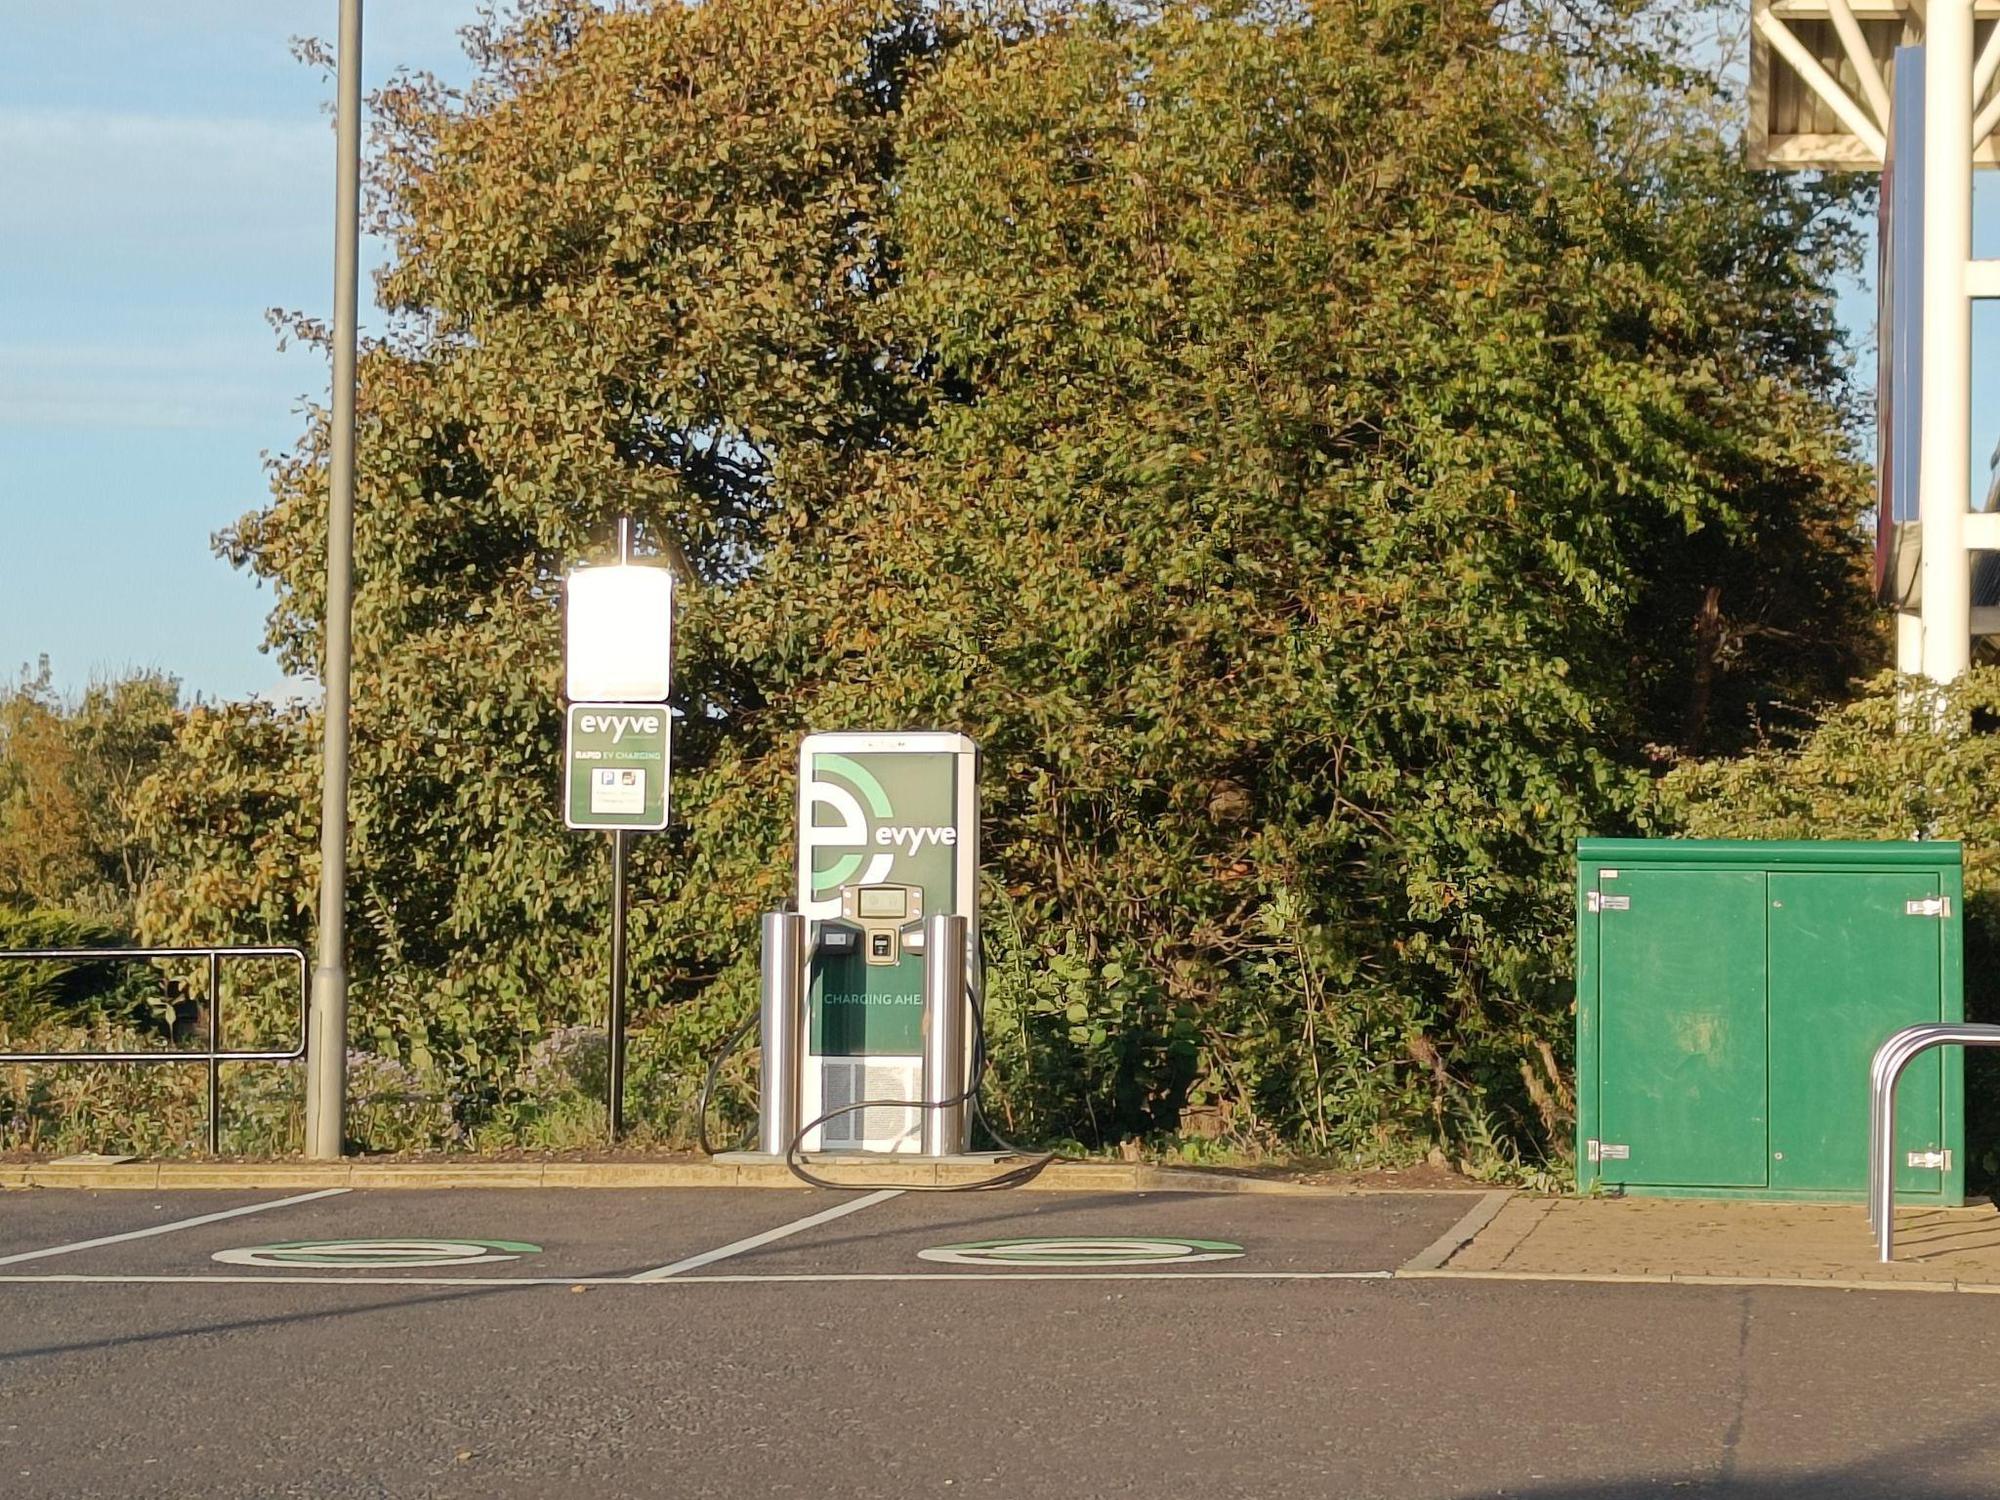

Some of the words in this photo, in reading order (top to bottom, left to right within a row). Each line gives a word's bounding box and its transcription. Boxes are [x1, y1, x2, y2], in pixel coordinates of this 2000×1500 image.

[580, 714, 659, 744] evyve
[875, 826, 957, 857] evyve
[824, 993, 892, 1005] CHARGING
[894, 993, 924, 1005] AHE
